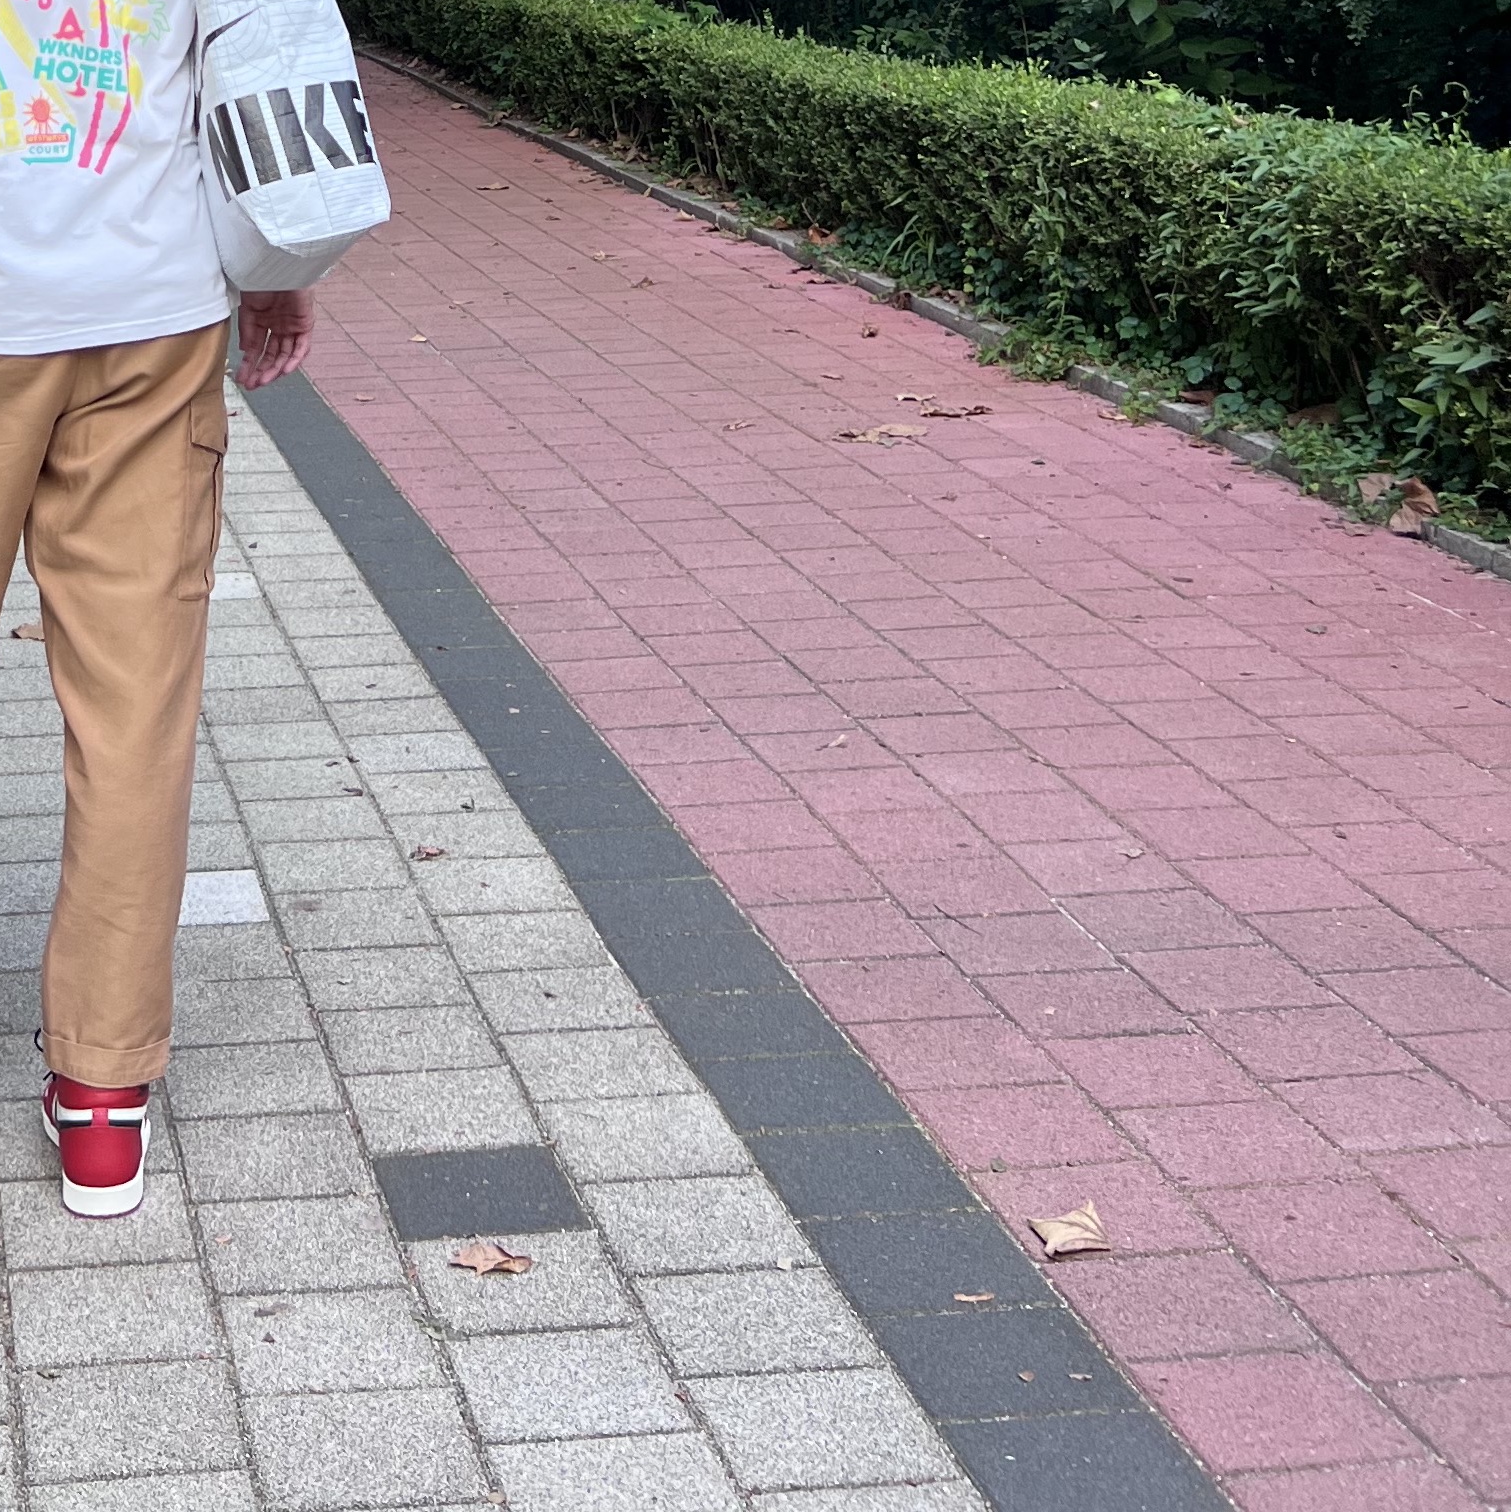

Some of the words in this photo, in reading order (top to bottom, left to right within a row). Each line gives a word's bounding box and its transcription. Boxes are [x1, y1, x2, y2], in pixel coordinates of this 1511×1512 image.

[39, 39, 122, 65] WKNDRS
[33, 57, 128, 92] HOTEL
[29, 144, 67, 155] COURT
[207, 80, 377, 204] NIKE
